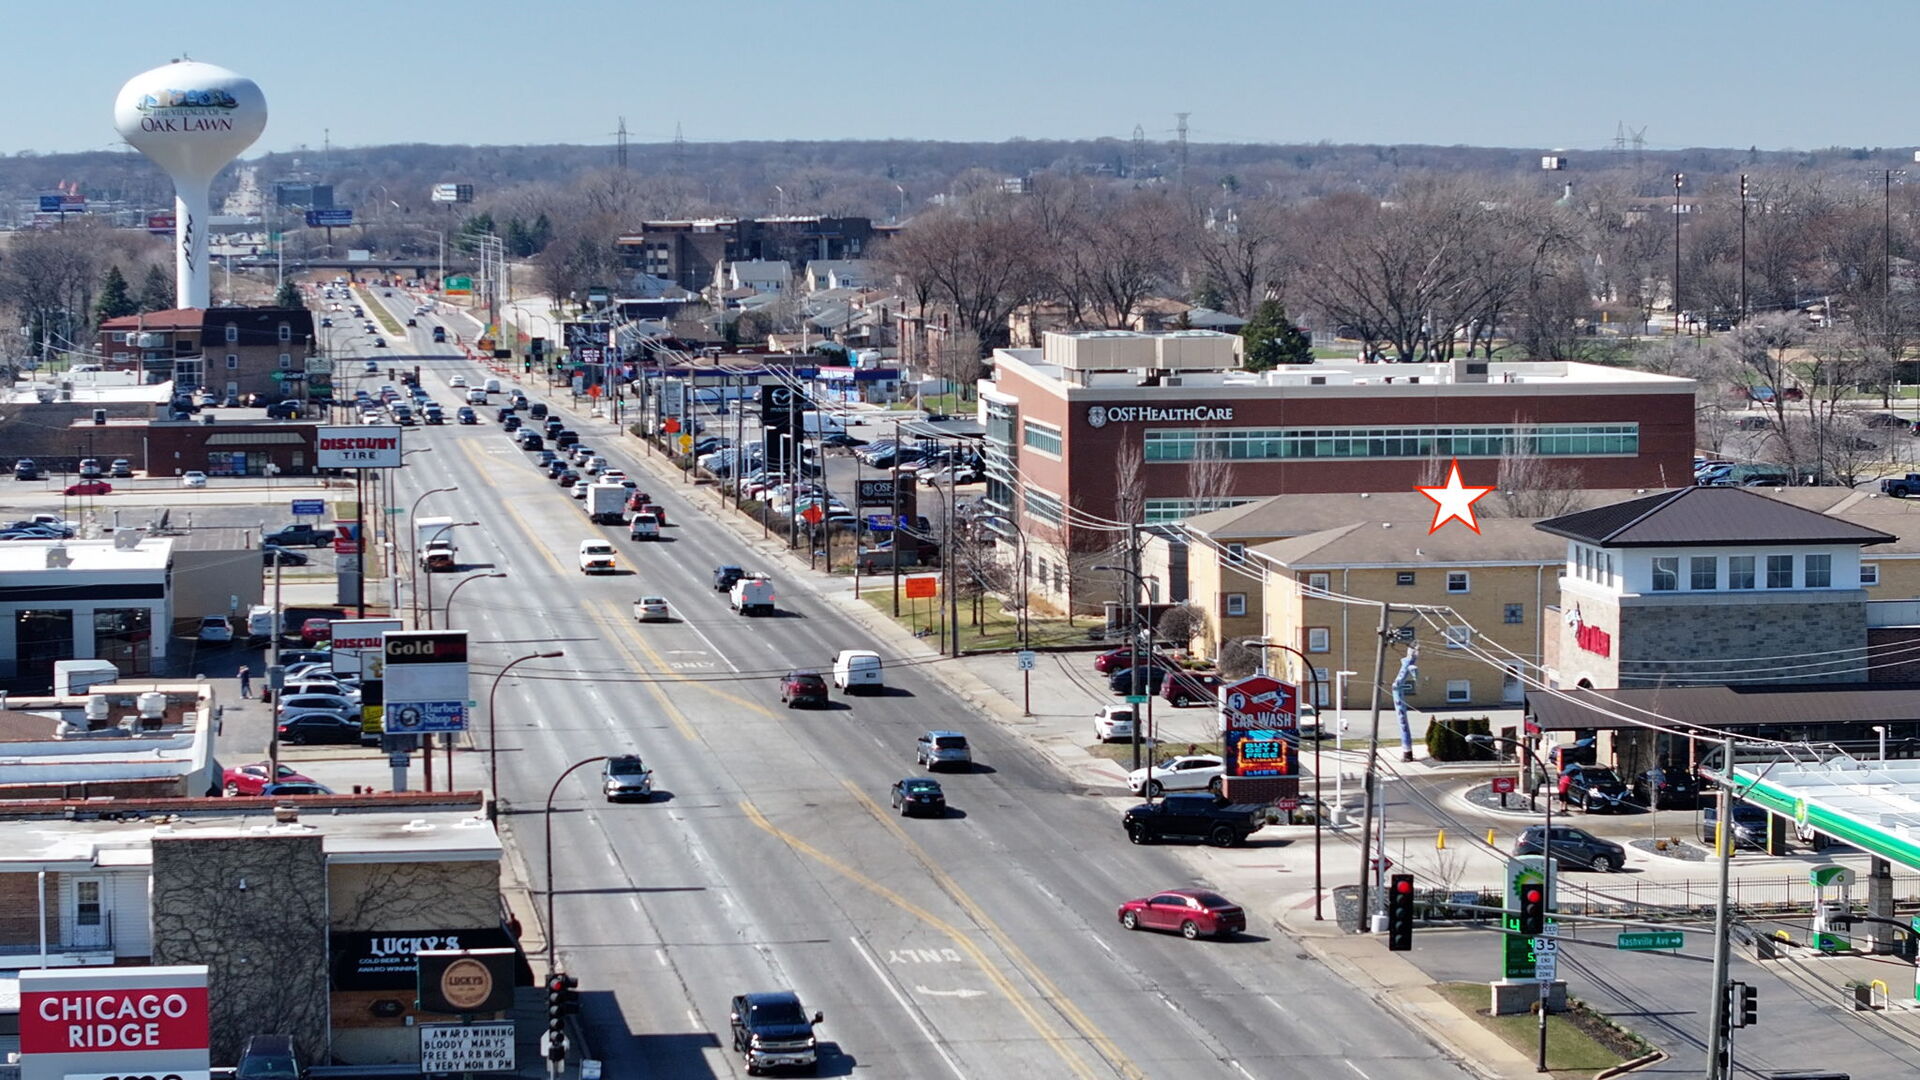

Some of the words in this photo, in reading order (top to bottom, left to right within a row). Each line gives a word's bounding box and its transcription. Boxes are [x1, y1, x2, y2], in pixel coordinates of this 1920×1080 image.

[141, 117, 177, 132] OAK
[183, 116, 232, 131] LAWN
[1108, 407, 1136, 421] OSF
[320, 438, 397, 450] DISCOUNT
[873, 483, 894, 492] OSF
[333, 638, 382, 649] DISCOU
[424, 702, 459, 713] Barber
[1233, 694, 1242, 711] 5
[424, 714, 451, 726] Shop
[1232, 711, 1255, 728] CAR
[1258, 711, 1292, 727] WASH
[371, 936, 460, 957] LUCKY'S
[1536, 940, 1556, 951] 35
[1620, 936, 1653, 946] Nashville
[889, 948, 962, 964] ONLY
[39, 994, 187, 1021] CHICAGO
[69, 1023, 159, 1047] RIDGE
[433, 1029, 469, 1038] AWARD
[472, 1028, 513, 1037] WINNING
[424, 1040, 463, 1049] BLOODY
[471, 1039, 505, 1048] MARYS
[423, 1051, 447, 1059] FREE
[427, 1061, 459, 1070] EVERY
[464, 1061, 484, 1069] MON
[498, 1060, 512, 1068] PM
